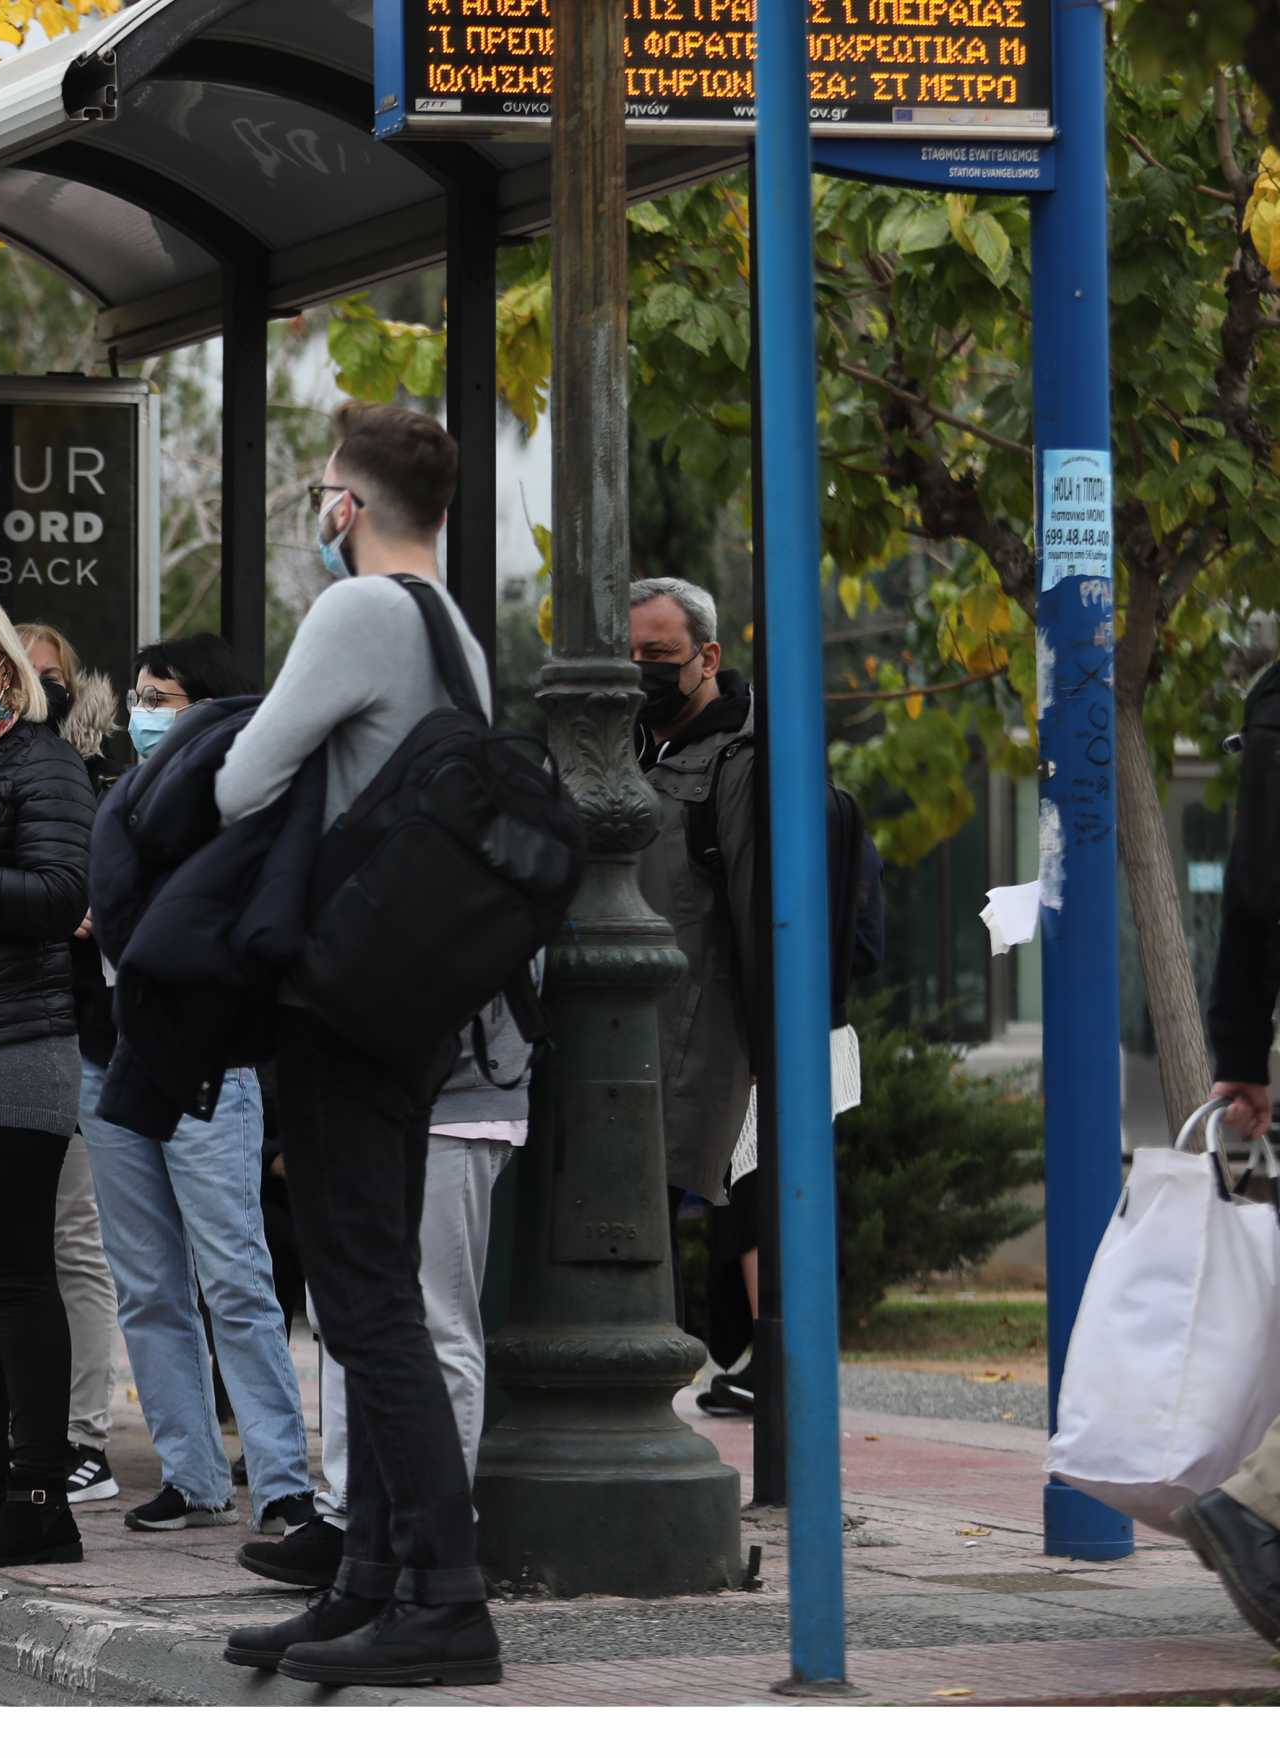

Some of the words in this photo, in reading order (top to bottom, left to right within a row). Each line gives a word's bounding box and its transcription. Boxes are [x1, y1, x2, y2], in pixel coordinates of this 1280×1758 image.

[917, 74, 1018, 103] ΜΕΤΡΟ
[921, 147, 968, 161] ΣΤΑΘΜΟΣ
[949, 167, 981, 178] STATION
[982, 168, 1040, 179] EVANGELISMOS
